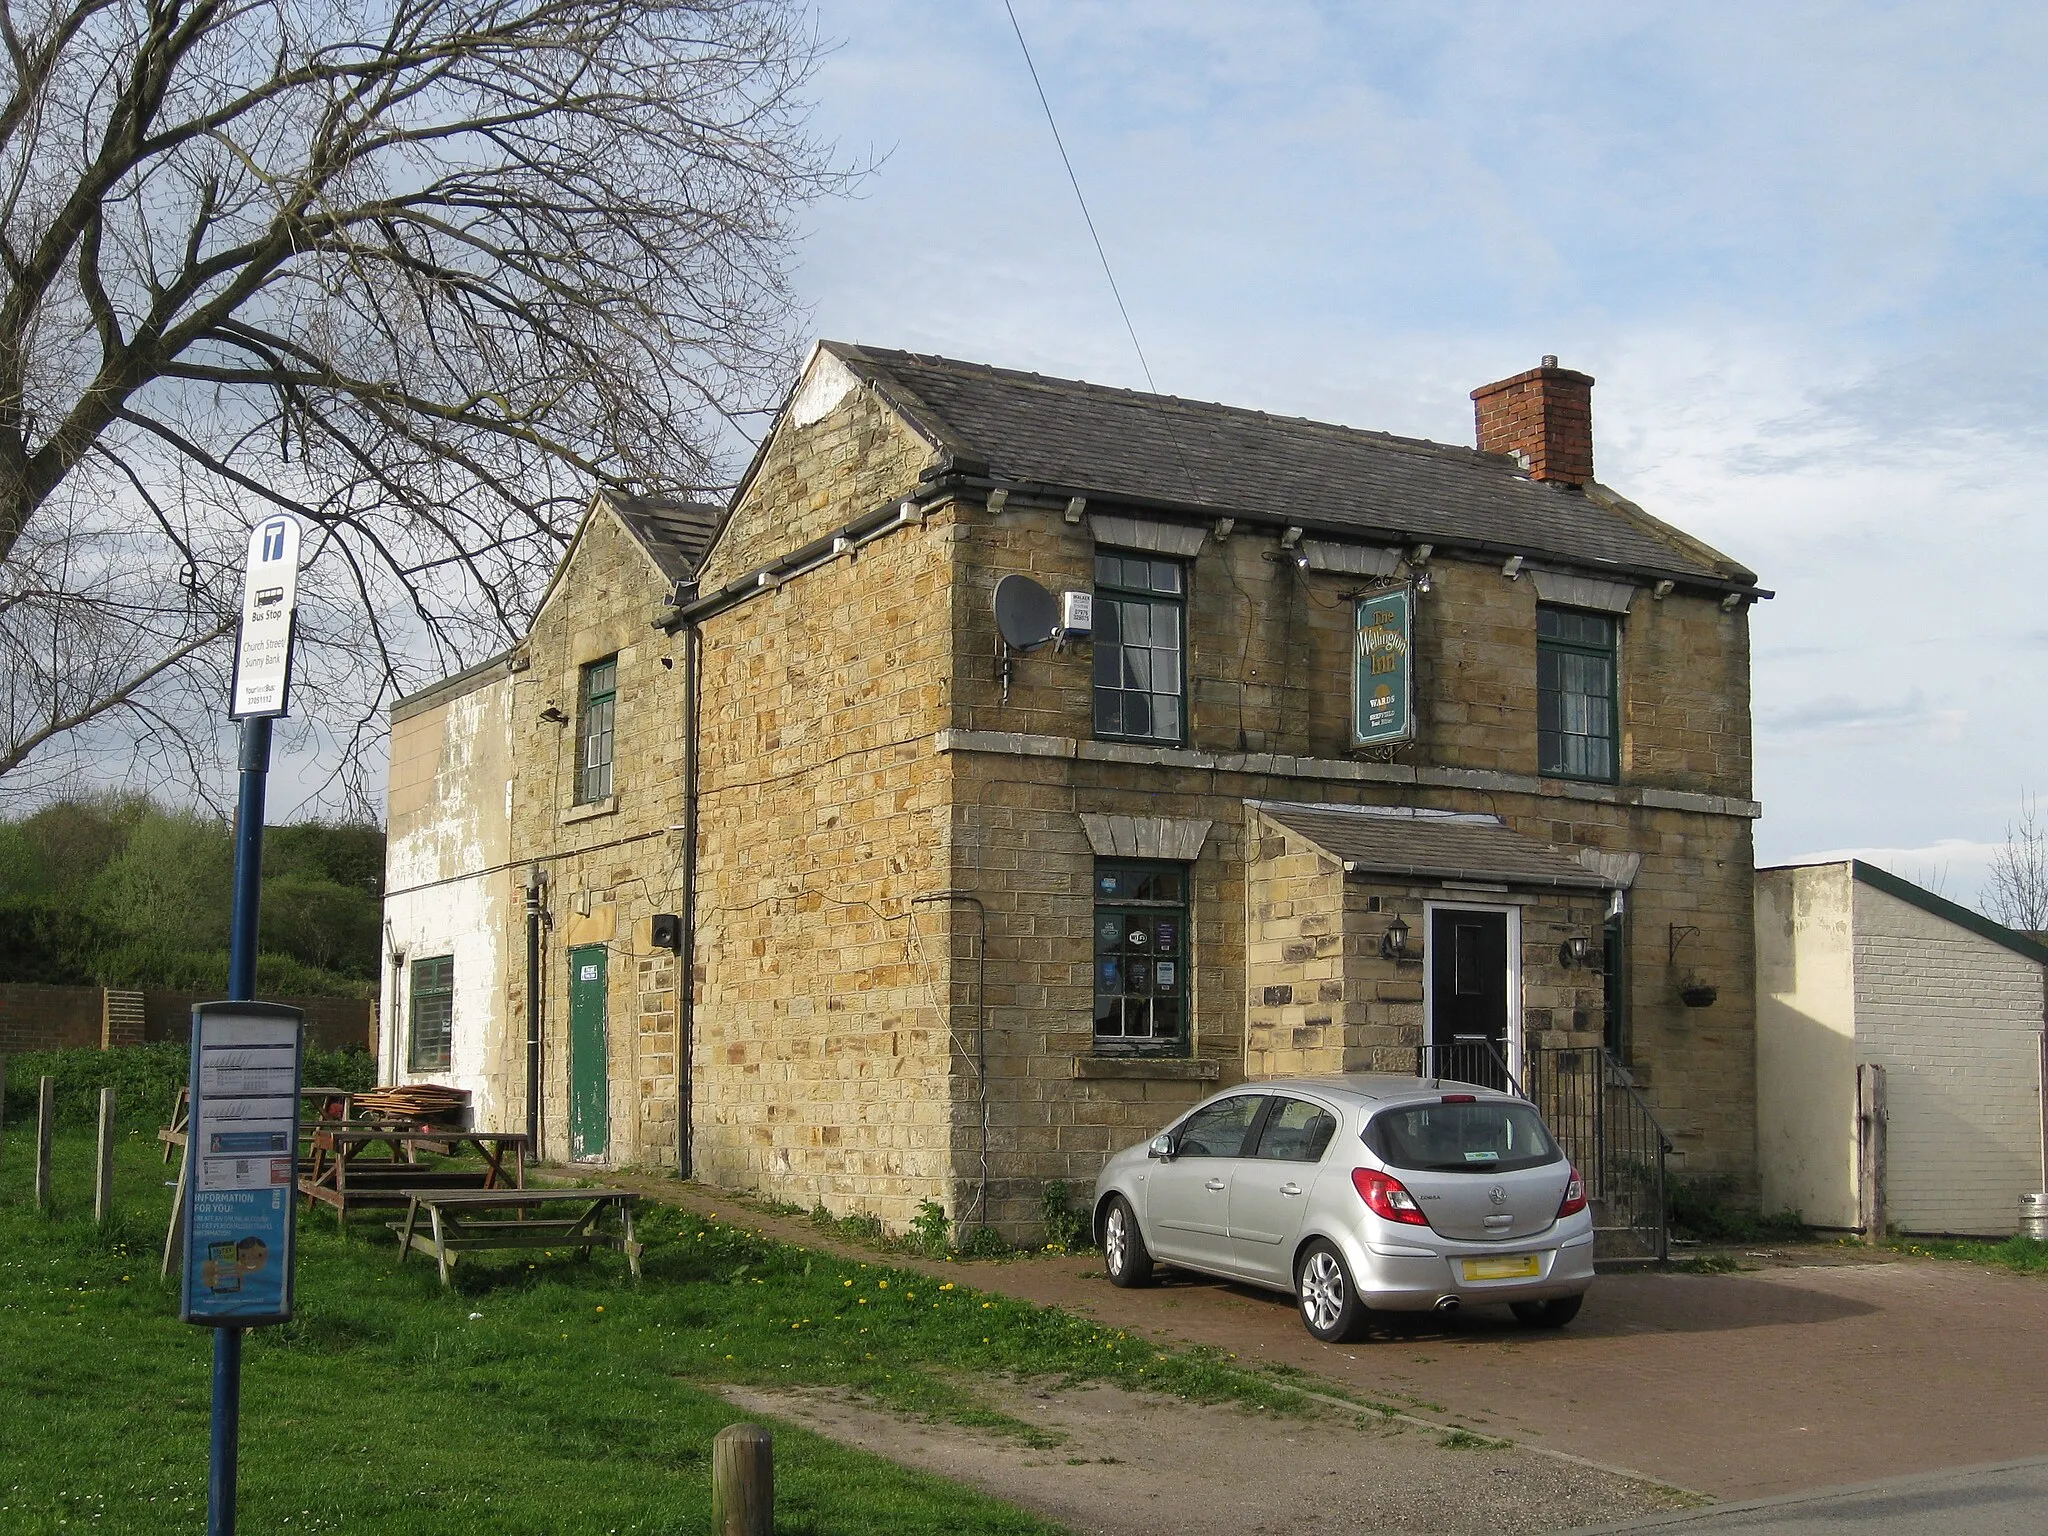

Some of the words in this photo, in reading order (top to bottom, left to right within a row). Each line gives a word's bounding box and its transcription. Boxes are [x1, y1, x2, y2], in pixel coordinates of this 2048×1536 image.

[252, 612, 264, 622] Bus
[266, 609, 282, 621] Stop
[1373, 610, 1395, 626] The
[243, 640, 264, 653] Church
[1357, 630, 1406, 657] Wellington
[245, 655, 264, 668] Sunny
[265, 653, 281, 665] Bank
[1371, 653, 1396, 676] Inn
[1369, 695, 1395, 708] WARDS
[194, 1192, 254, 1204] INFORMATION
[194, 1203, 211, 1213] FOR
[213, 1203, 233, 1213] YOU!
